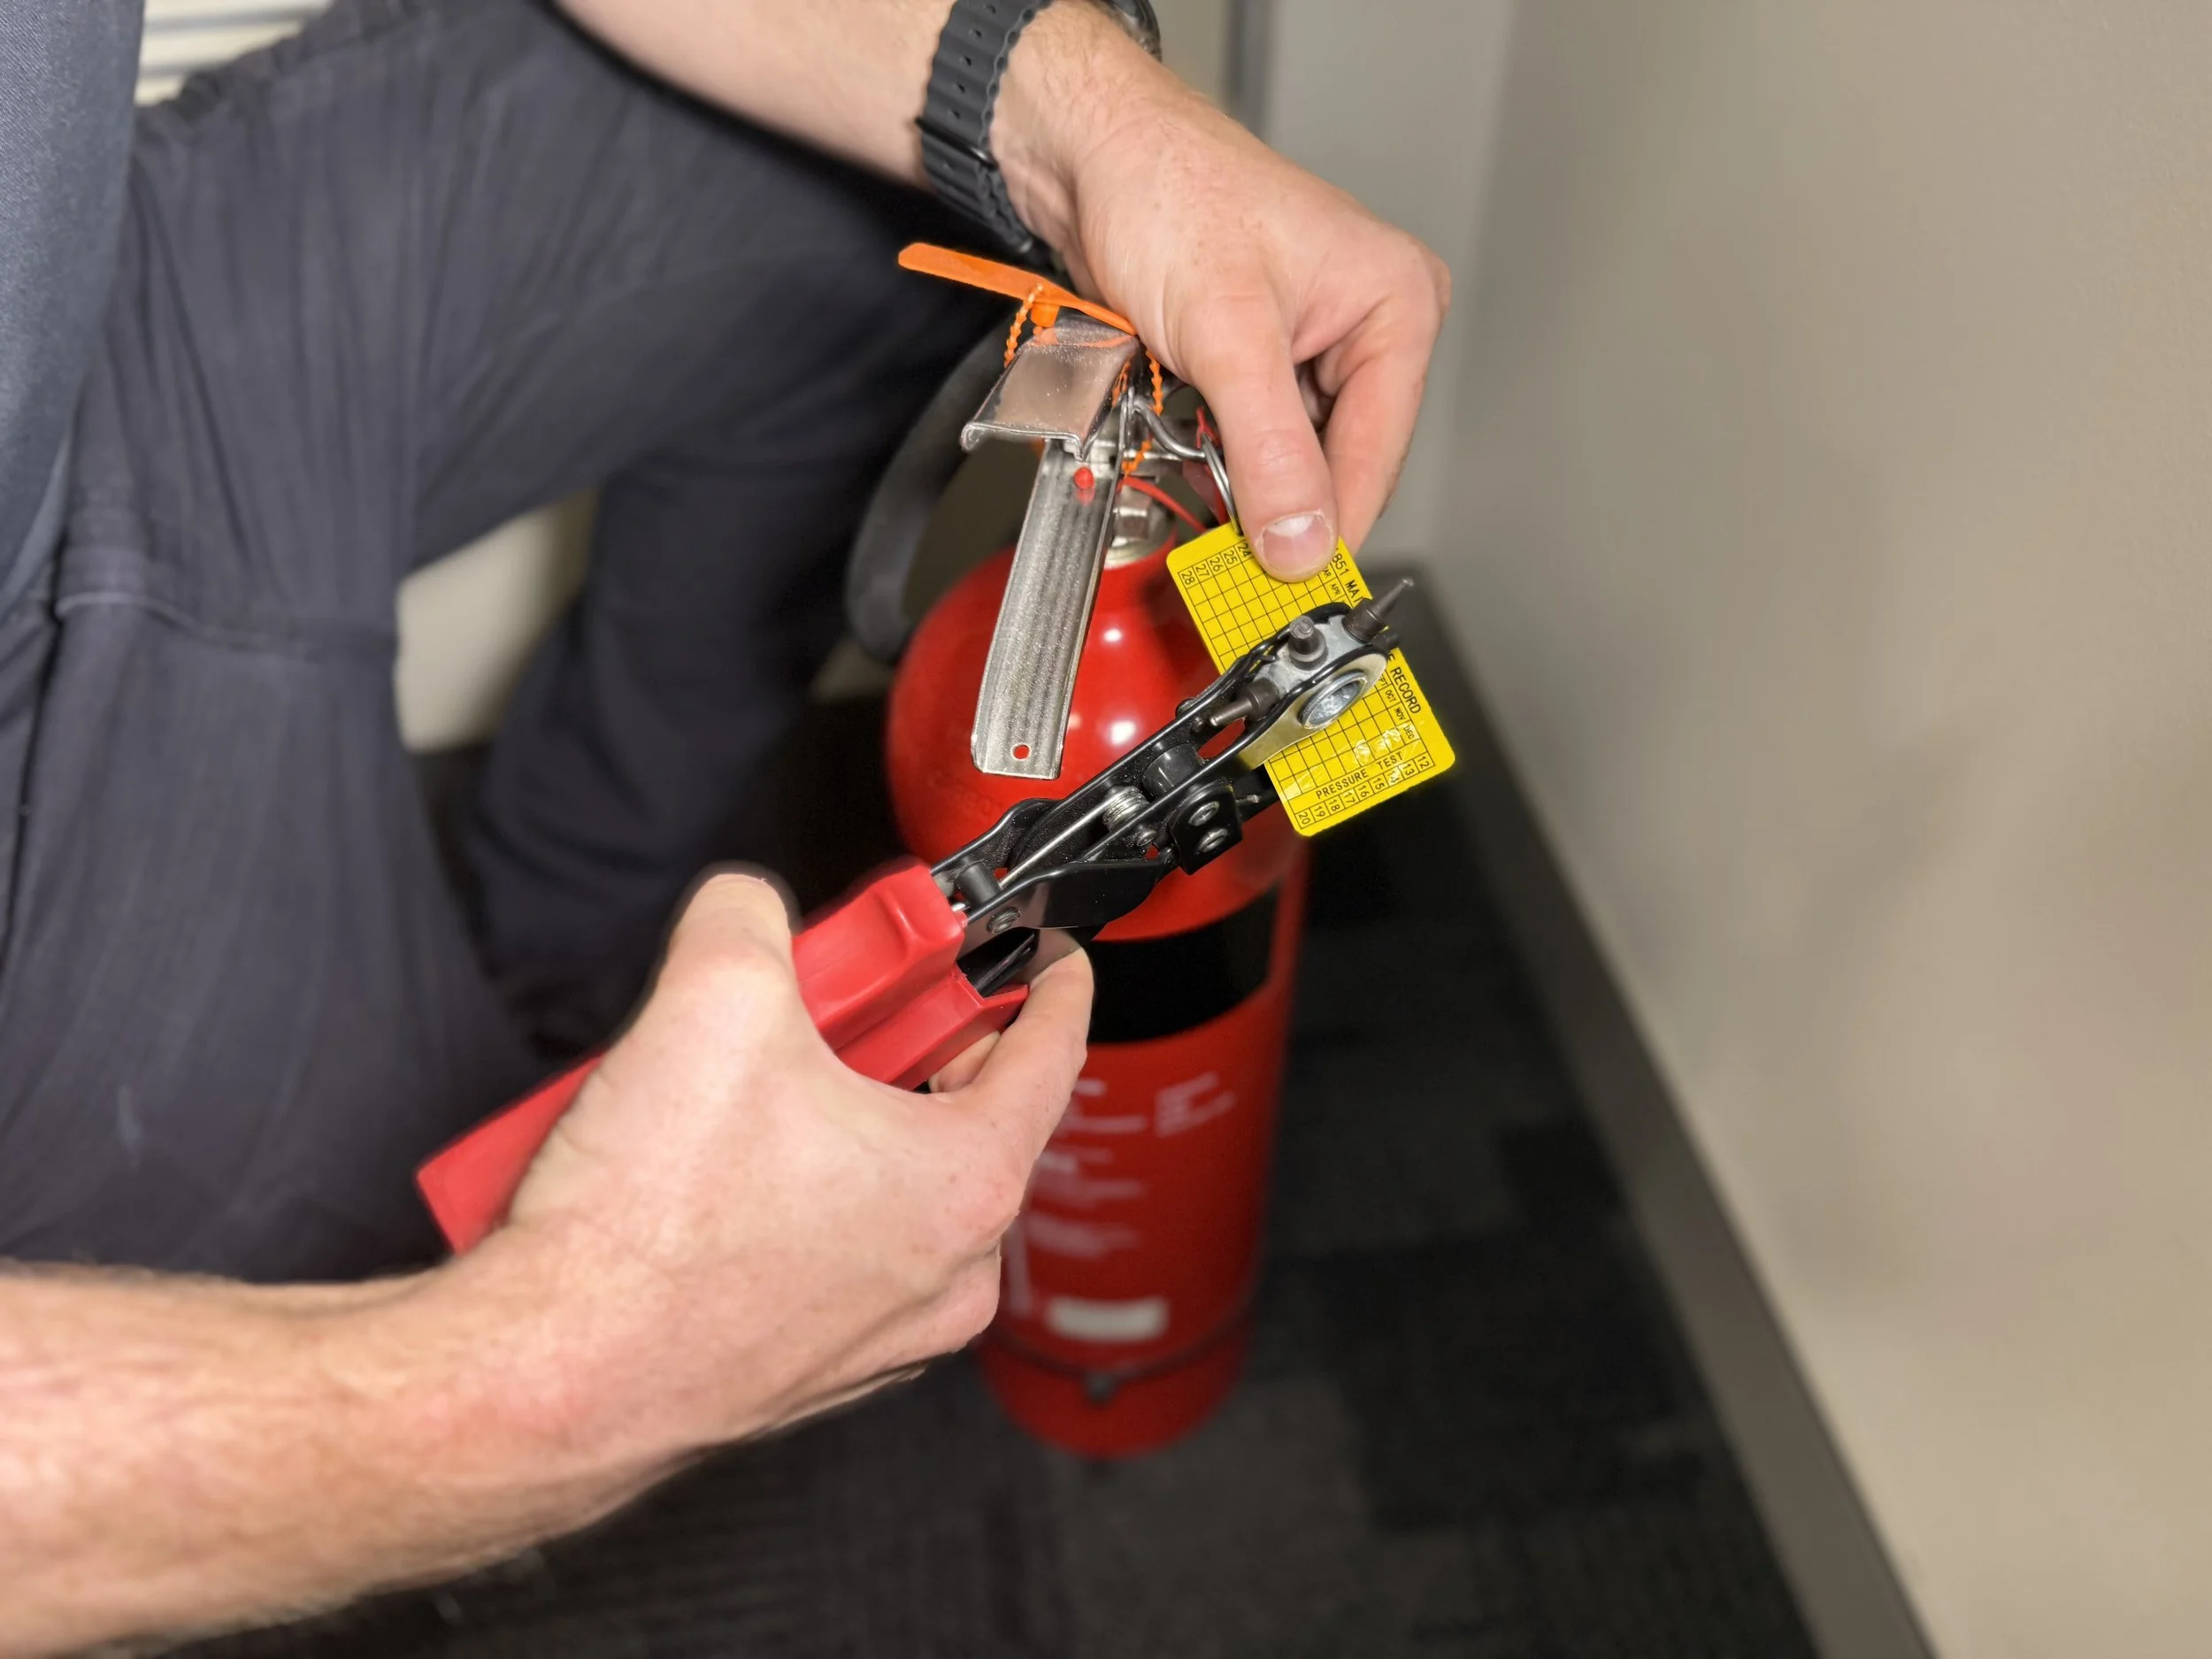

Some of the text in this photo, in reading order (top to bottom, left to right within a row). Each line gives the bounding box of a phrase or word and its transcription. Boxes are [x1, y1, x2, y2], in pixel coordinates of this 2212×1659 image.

[1237, 542, 1252, 557] 24
[1223, 549, 1238, 565] 25
[1195, 564, 1210, 577] 27
[1210, 557, 1223, 572] 26
[1181, 570, 1195, 585] 28
[1332, 583, 1340, 596] APR
[1332, 548, 1421, 714] 851 RECORD
[1385, 689, 1396, 703] OCT
[1394, 707, 1405, 720] NOV
[1403, 725, 1415, 740] DEC
[1417, 756, 1429, 769] 12
[1316, 751, 1402, 800] PRESSURE TEST
[1402, 764, 1415, 776] 13
[1373, 778, 1385, 790] 15
[1343, 792, 1356, 803] 17
[1358, 785, 1370, 797] 16
[1314, 805, 1325, 818] 19
[1329, 799, 1340, 811] 18
[1298, 811, 1310, 825] 20
